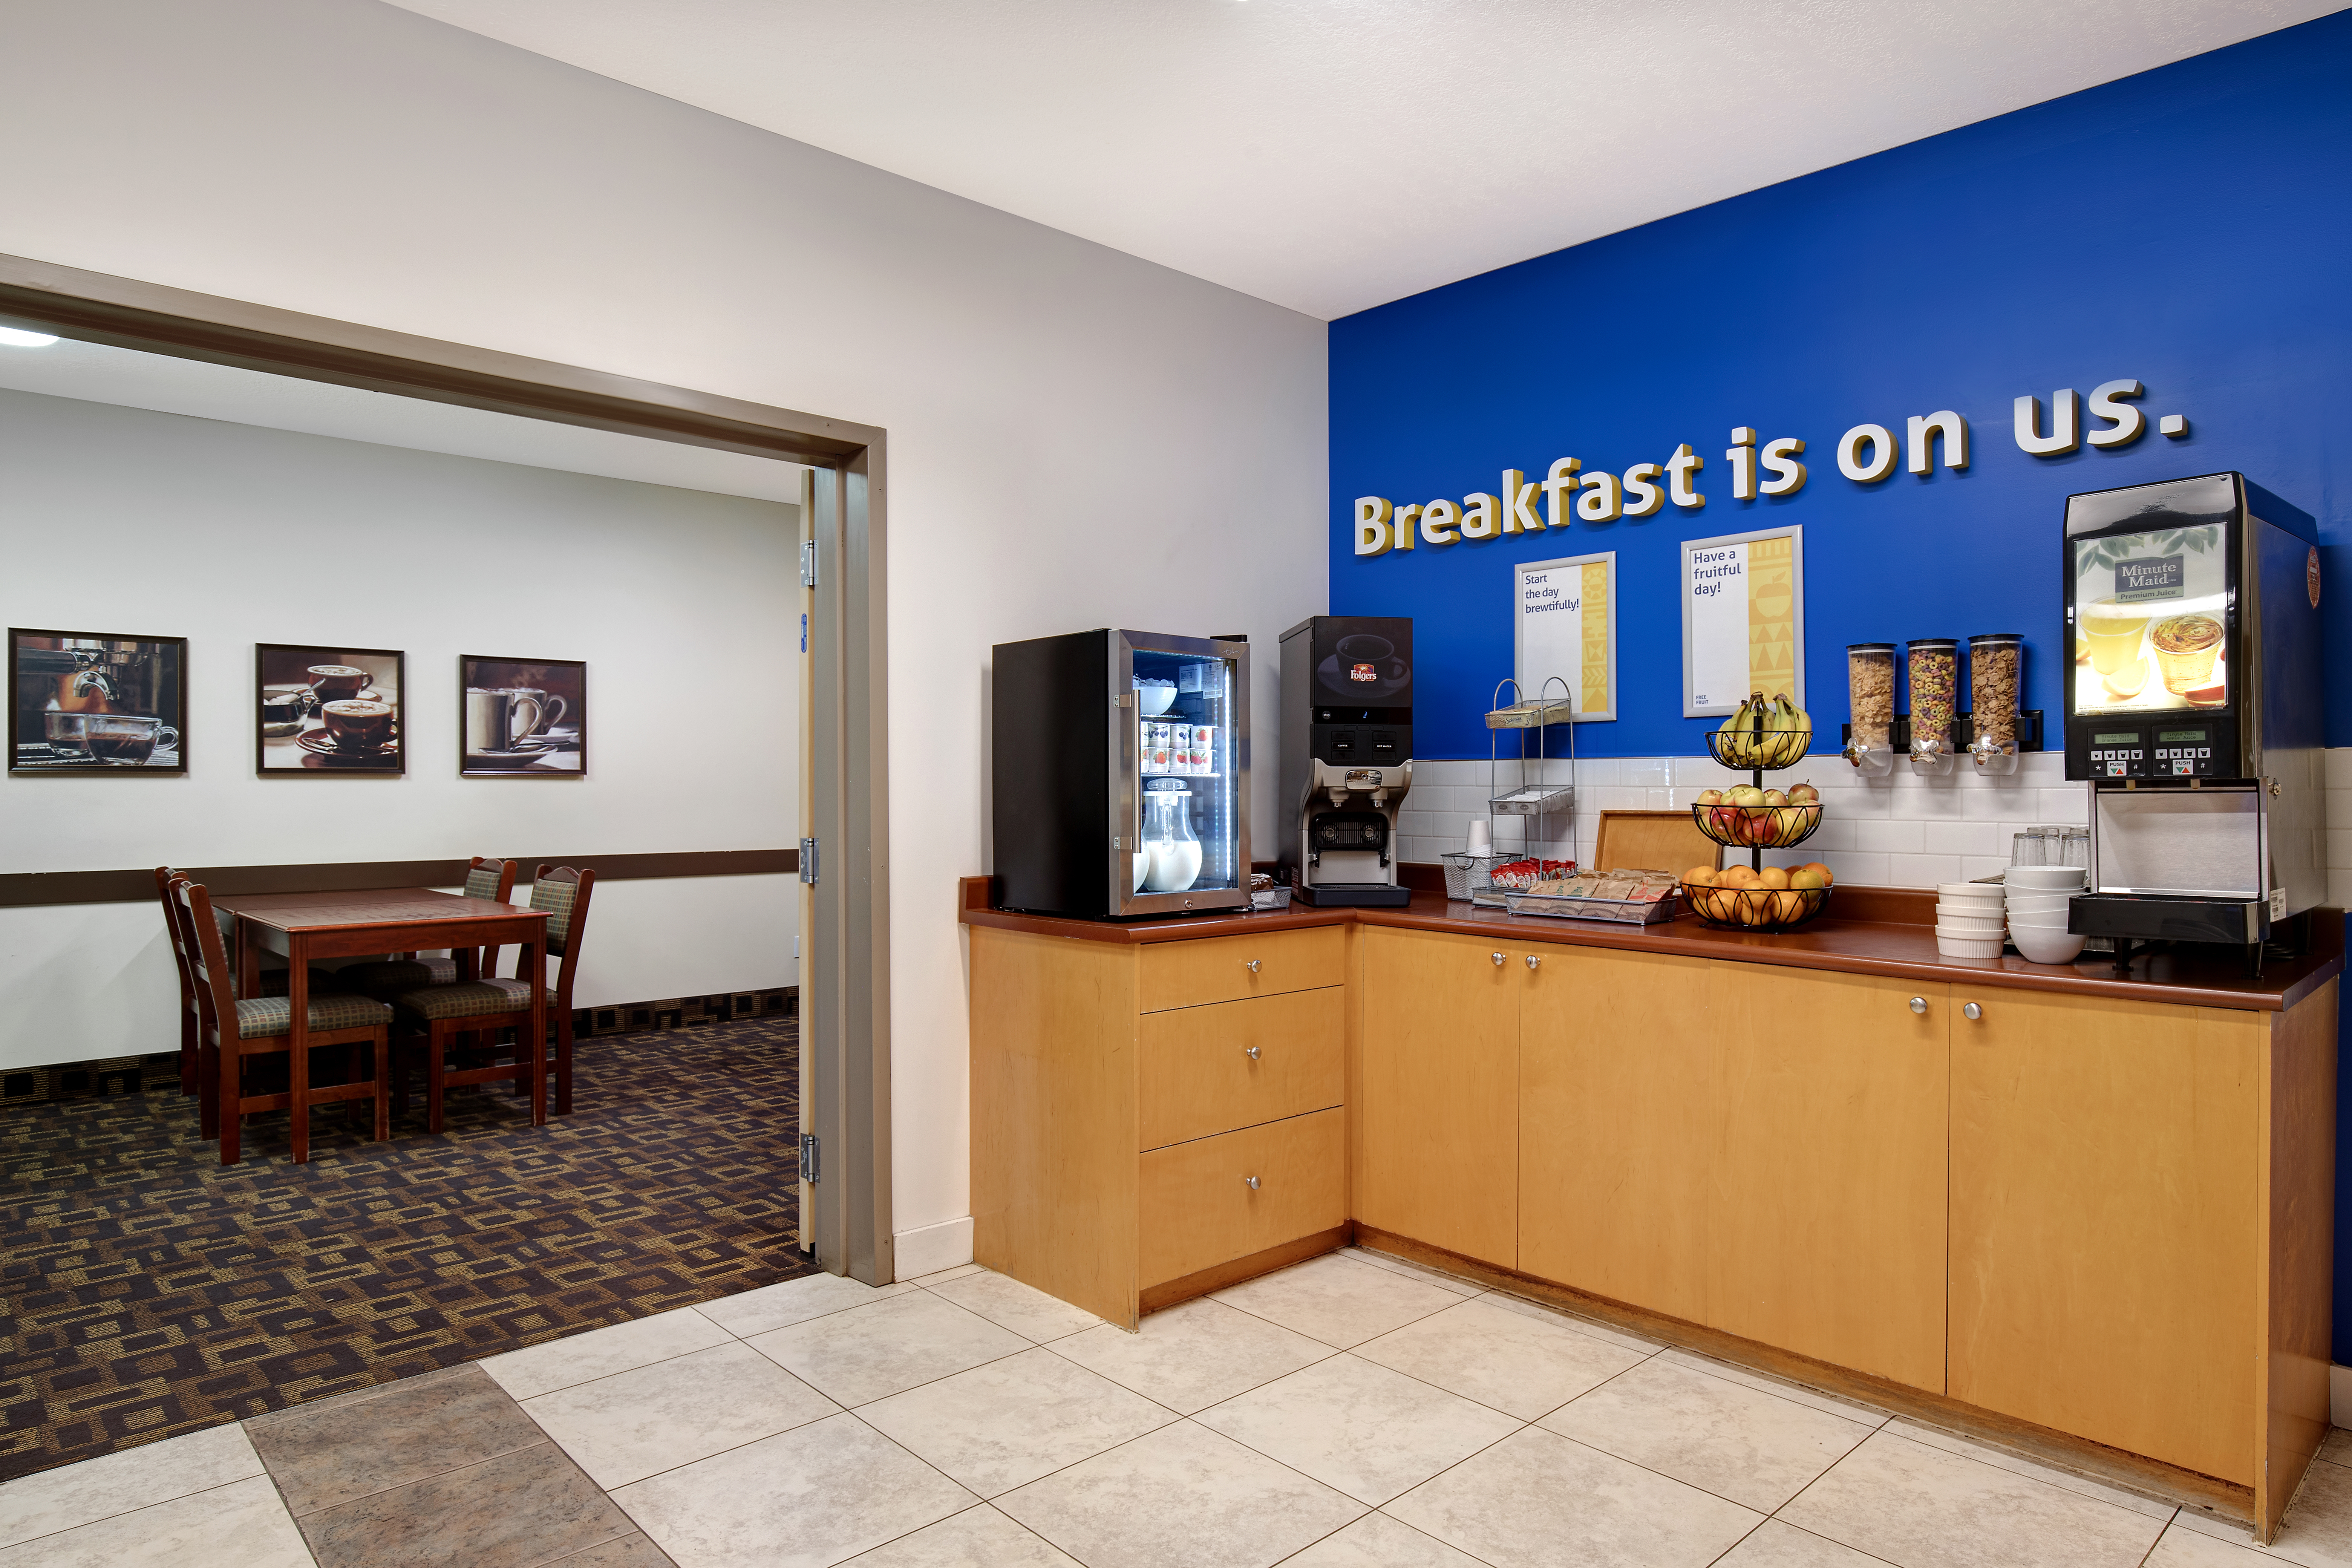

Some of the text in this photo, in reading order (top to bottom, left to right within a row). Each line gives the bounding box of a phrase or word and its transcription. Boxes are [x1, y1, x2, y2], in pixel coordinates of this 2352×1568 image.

[1354, 379, 2188, 556] Breakfast is on us.
[1694, 552, 1725, 564] Have
[1694, 563, 1741, 579] fruitful
[2122, 563, 2176, 577] Minute
[1525, 574, 1547, 584] Start
[2129, 573, 2168, 587] Maid
[1525, 588, 1559, 599] the day
[1694, 582, 1720, 596] day!
[1526, 599, 1579, 613] brewtifully!
[1351, 670, 1377, 681] Folgers
